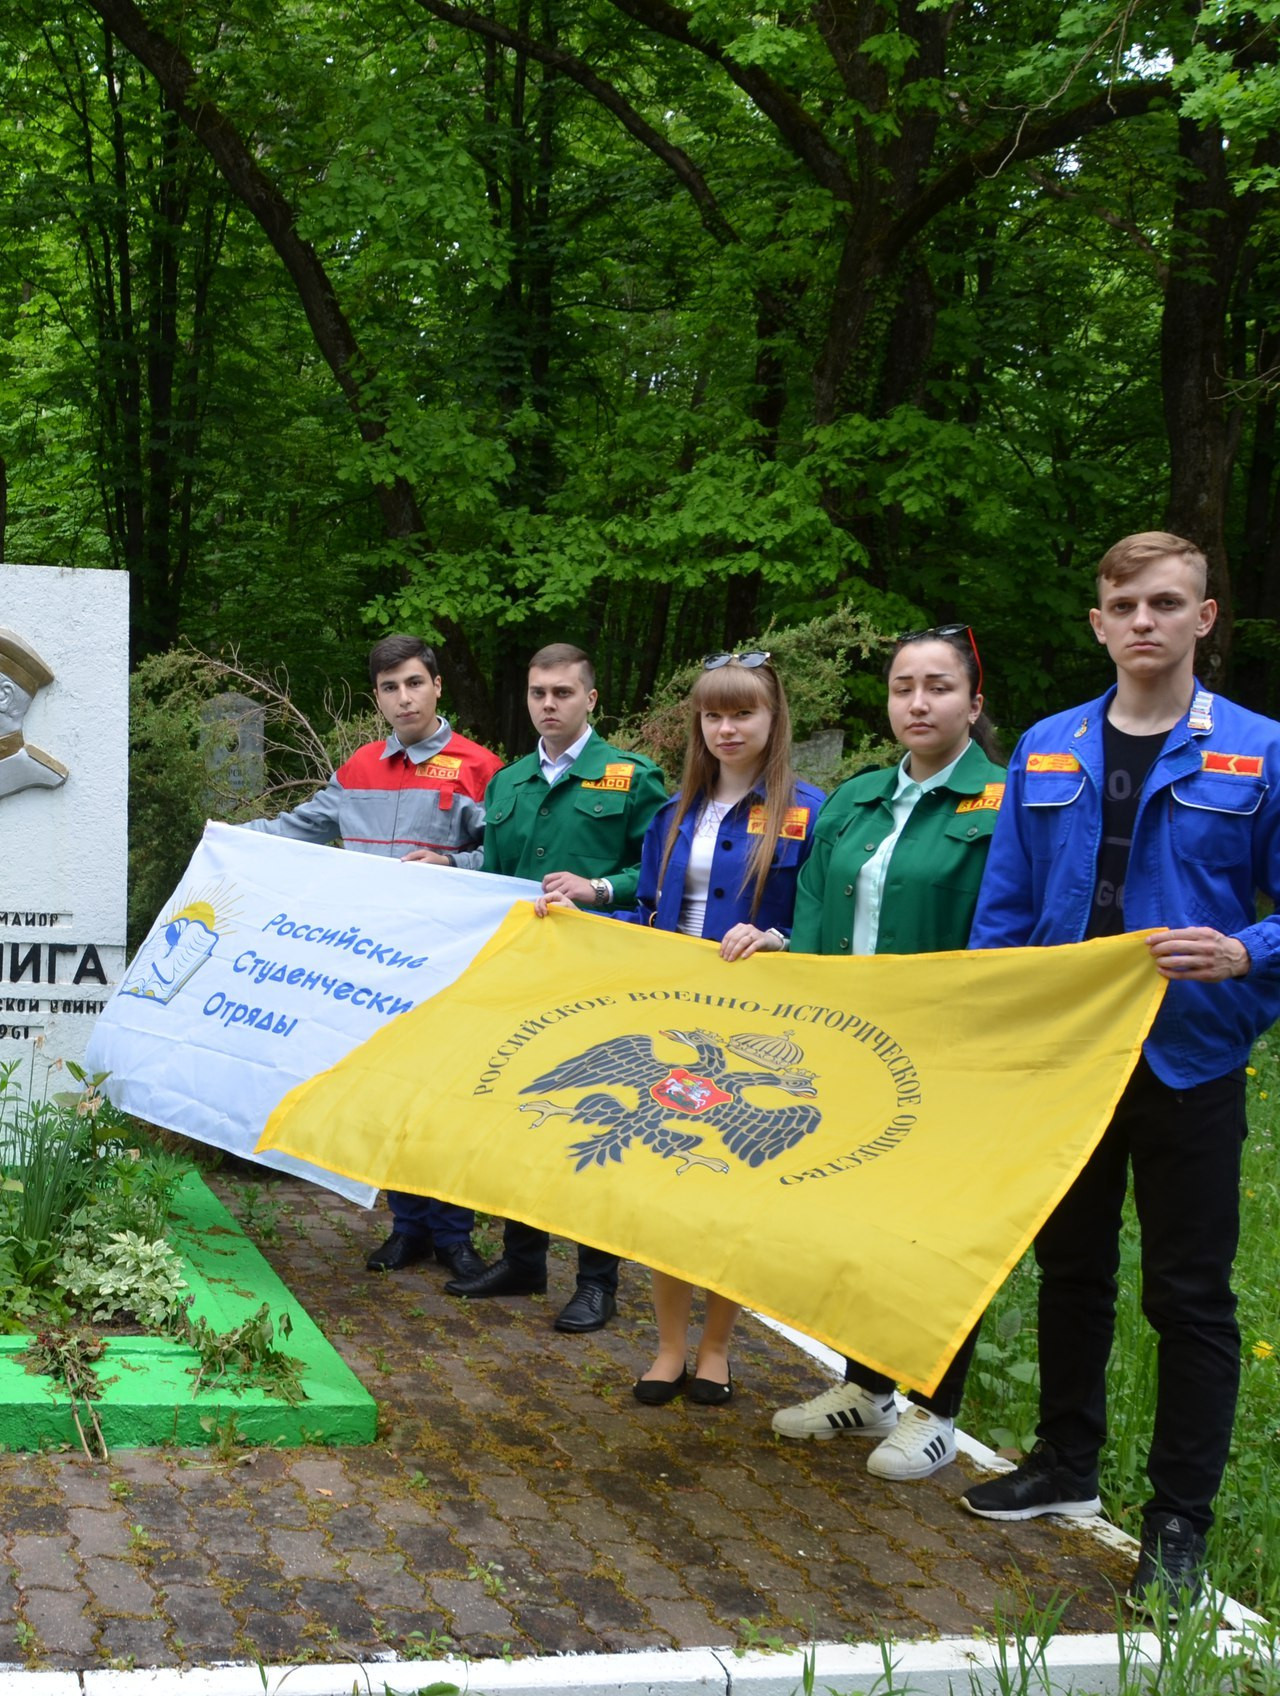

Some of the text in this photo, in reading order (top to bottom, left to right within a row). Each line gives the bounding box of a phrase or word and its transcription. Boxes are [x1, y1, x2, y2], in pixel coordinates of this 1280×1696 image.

[262, 912, 428, 969] Российские
[233, 950, 414, 1016] Студенчески
[203, 991, 298, 1037] Отряды
[473, 995, 617, 1096] РОССИЙСКОЕ
[779, 1114, 917, 1185] ОБЩЕСТВО
